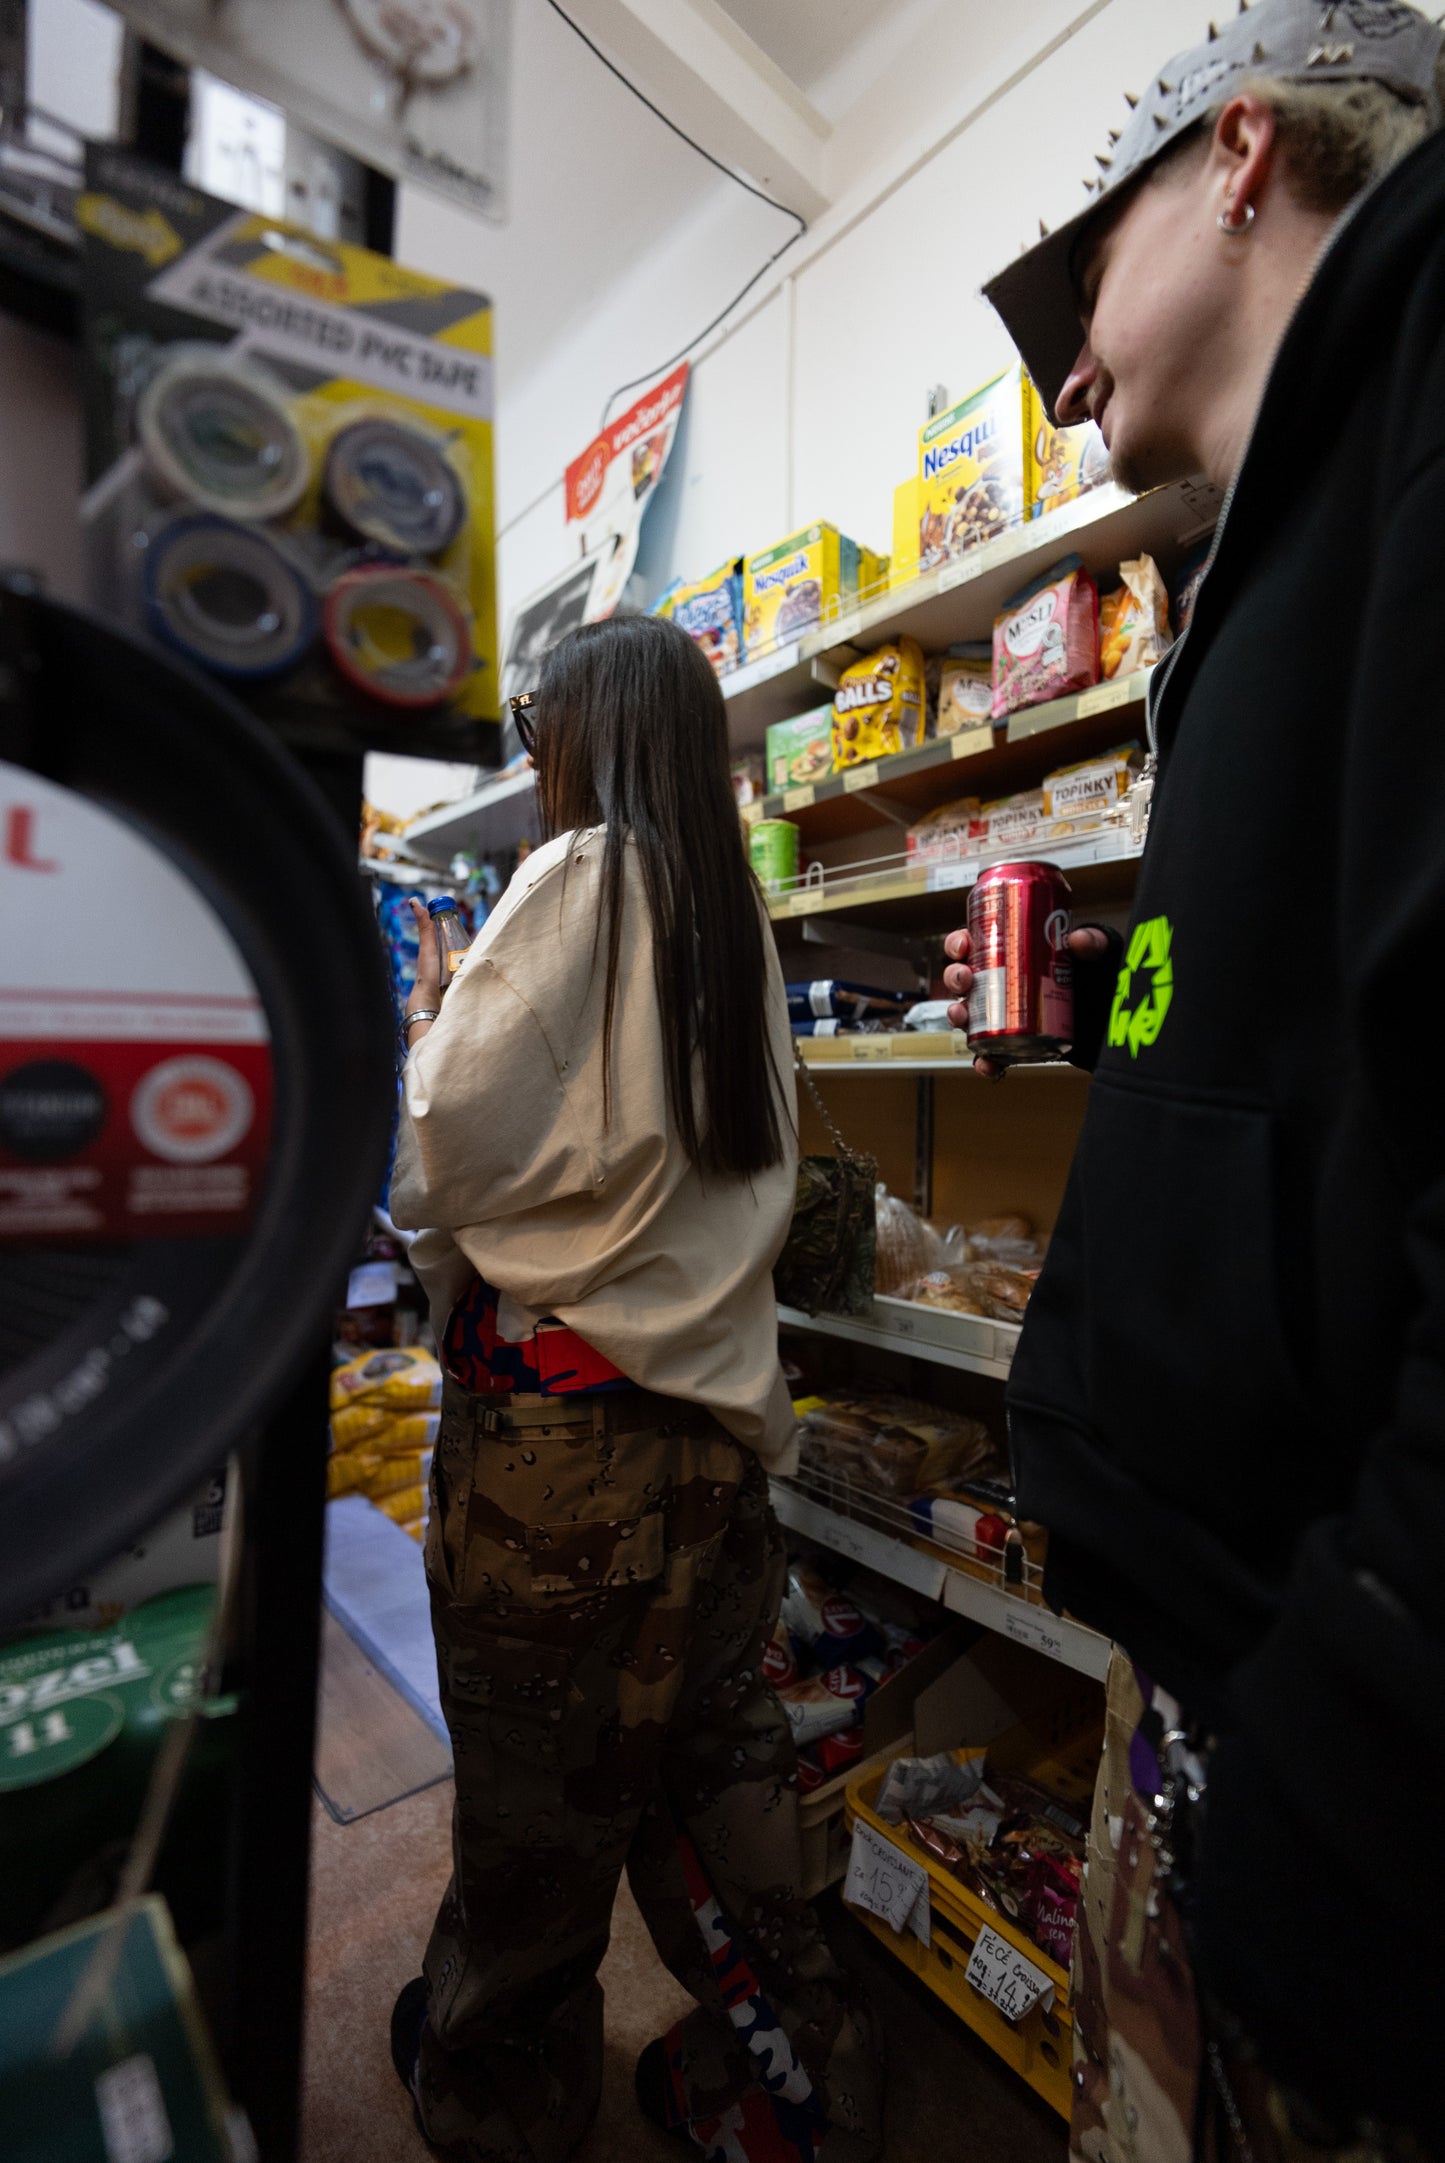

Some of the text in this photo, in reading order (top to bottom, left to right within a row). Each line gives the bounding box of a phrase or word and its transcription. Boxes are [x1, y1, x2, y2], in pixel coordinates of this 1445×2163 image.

[192, 276, 355, 354] ASSORTED
[357, 330, 412, 378] PVC
[416, 351, 480, 399] TAPE
[923, 410, 997, 480] Nesqui
[754, 554, 809, 592] Nesquik
[1054, 776, 1114, 801] TOPINKY
